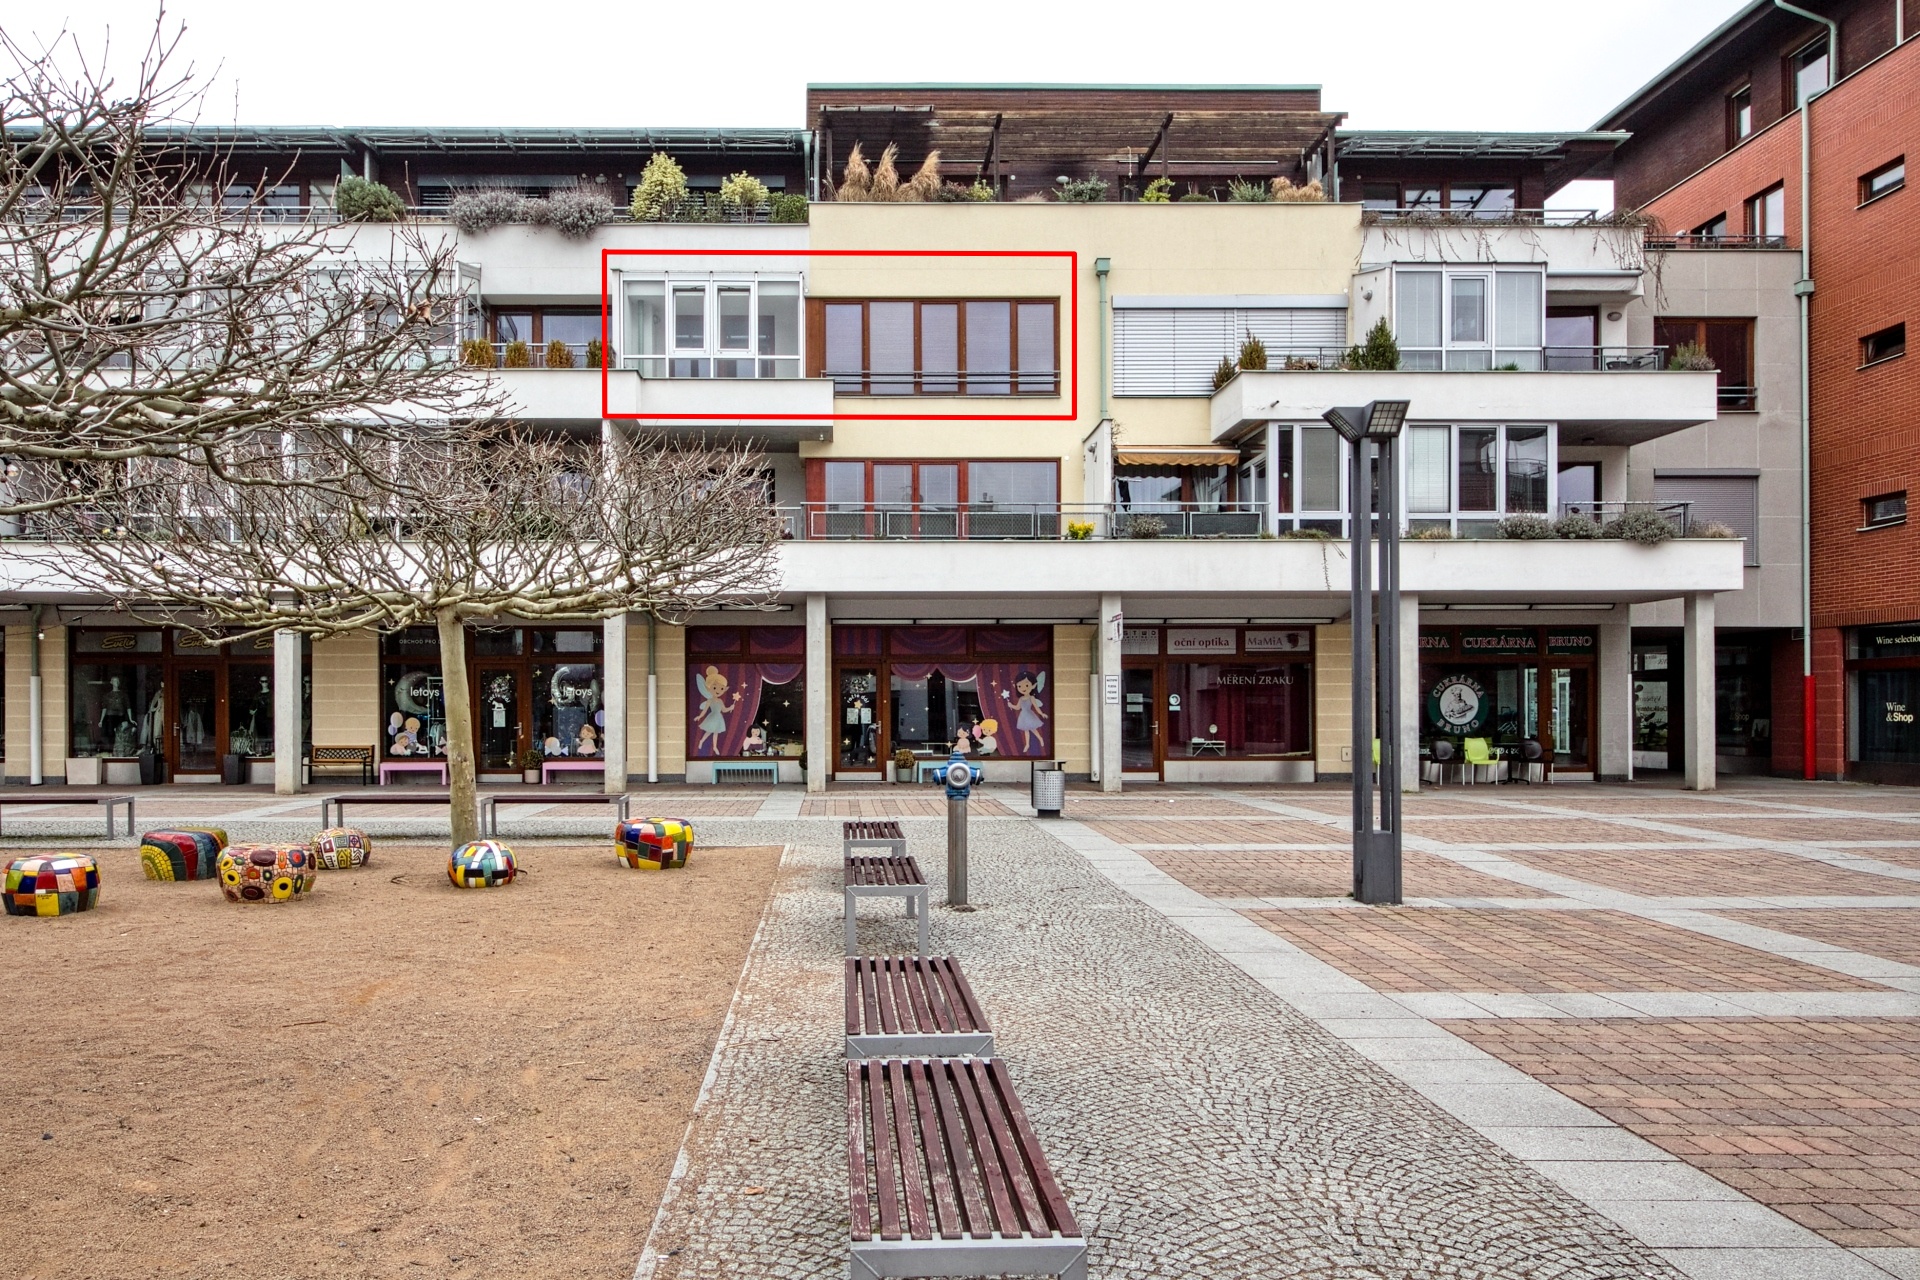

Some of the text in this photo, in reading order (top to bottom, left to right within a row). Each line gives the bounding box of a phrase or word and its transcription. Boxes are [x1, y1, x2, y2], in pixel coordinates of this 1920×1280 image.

[101, 634, 137, 649] Evelin
[1174, 637, 1230, 648] oční optika
[1248, 637, 1283, 646] MaMiA
[1462, 635, 1536, 648] CUKRÁRNA
[1549, 636, 1592, 647] BRUNO
[1876, 636, 1893, 645] Wine
[1217, 673, 1294, 685] MĚŘENÍ ZRAKU
[1433, 674, 1485, 698] CUKRÁRNA
[410, 686, 440, 699] letoys
[563, 686, 593, 699] letoys
[1886, 702, 1906, 712] Wine
[1886, 712, 1914, 723] &Shop
[1437, 720, 1479, 734] BRUNO
